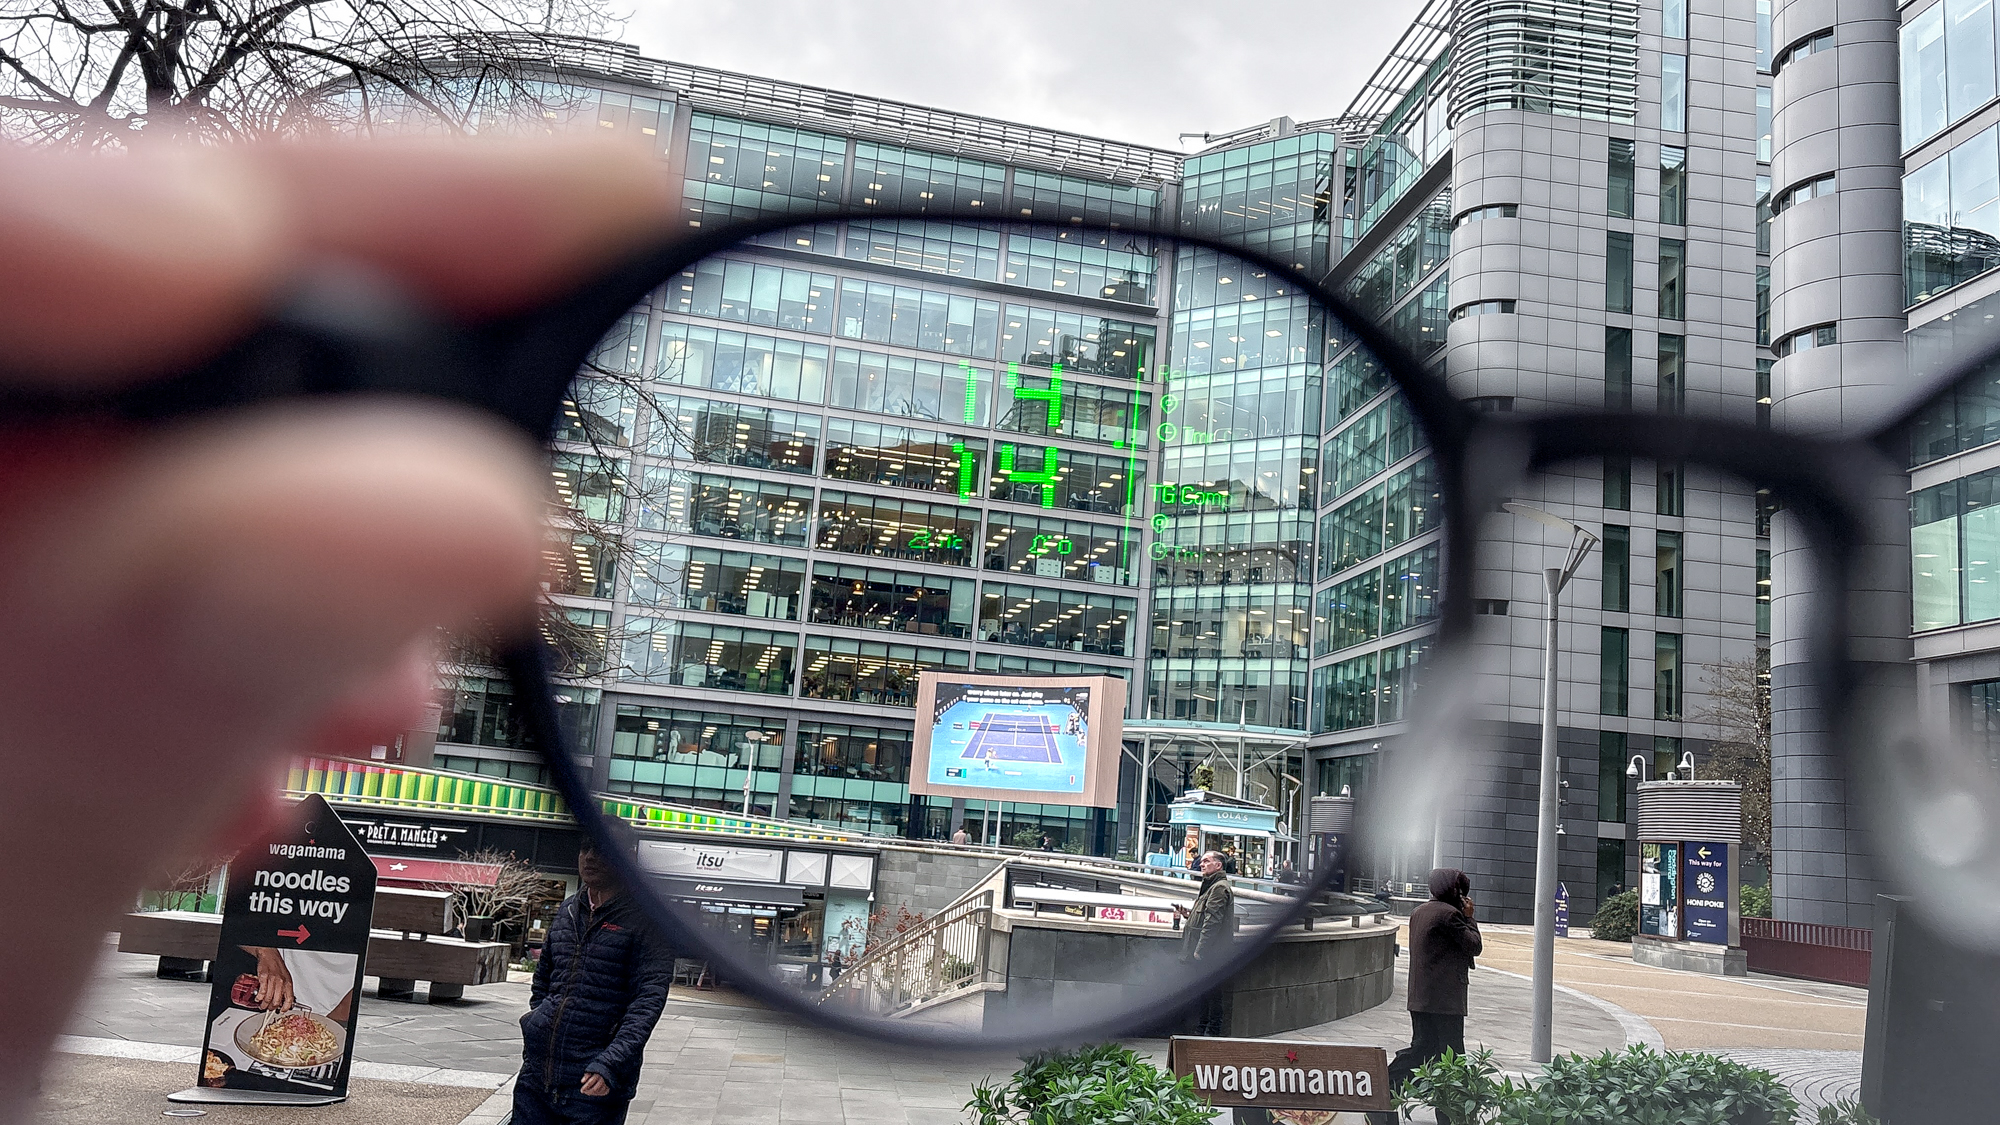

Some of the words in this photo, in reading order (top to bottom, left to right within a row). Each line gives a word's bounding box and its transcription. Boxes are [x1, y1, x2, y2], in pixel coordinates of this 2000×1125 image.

[958, 359, 1063, 427] 14
[951, 442, 1059, 509] 14
[1149, 483, 1176, 504] TG
[1217, 812, 1248, 821] LOLA'S
[367, 825, 389, 840] PRET
[390, 828, 397, 841] A
[400, 828, 438, 844] MANGER
[269, 844, 346, 860] wagamama
[697, 852, 724, 867] itsu
[254, 870, 350, 893] noodles
[695, 884, 724, 892] itsu
[249, 892, 293, 915] this
[299, 899, 349, 924] way
[1686, 899, 1703, 907] HONI
[1704, 900, 1724, 909] POKE
[1195, 1064, 1372, 1099] wagamama
